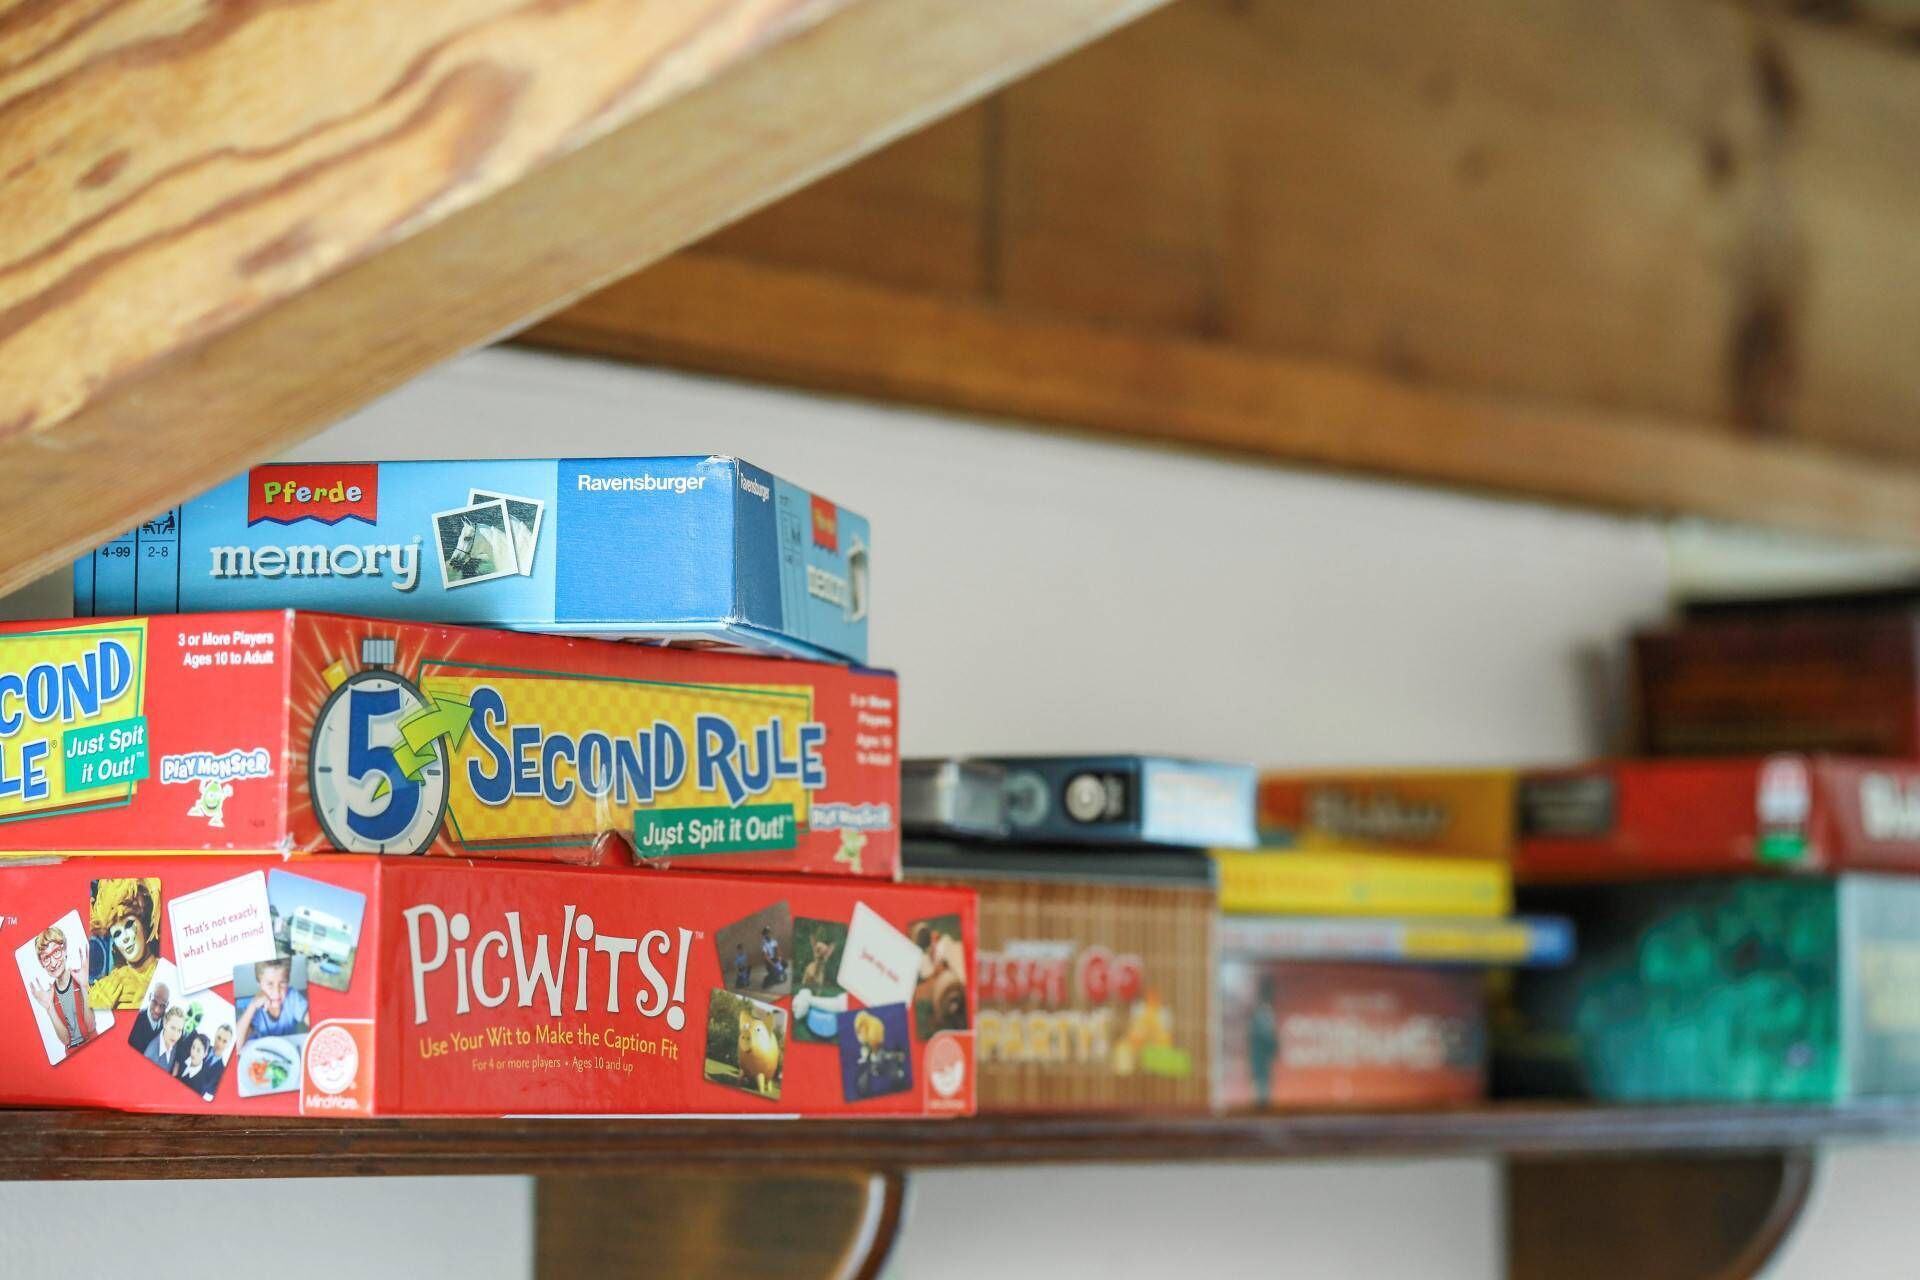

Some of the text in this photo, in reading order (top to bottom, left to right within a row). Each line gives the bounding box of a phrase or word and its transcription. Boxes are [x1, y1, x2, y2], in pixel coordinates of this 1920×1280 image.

[263, 480, 363, 504] Pferde
[577, 473, 707, 495] Ravensburger
[102, 546, 131, 558] 4-99
[147, 545, 169, 558] 2-8
[208, 542, 420, 592] memory
[178, 629, 275, 649] 3 or More Players
[183, 649, 275, 670] Ages 10 to Adult
[0, 637, 134, 738] COND
[66, 724, 145, 759] Just Spit
[81, 753, 136, 784] it Out!
[345, 684, 827, 842] 5 SECOND RULE
[643, 821, 684, 847] Just
[687, 818, 725, 850] Spit
[728, 817, 742, 842] it
[745, 815, 785, 842] Out!
[182, 903, 259, 938] That's not exactly
[183, 944, 206, 960] what
[211, 933, 229, 949] had
[230, 933, 240, 945] in
[241, 920, 265, 940] mind
[419, 1021, 680, 1061] Use Your Wit to Make the Caption Fit
[472, 1055, 634, 1076] For 4 or more players Ages 10 and up
